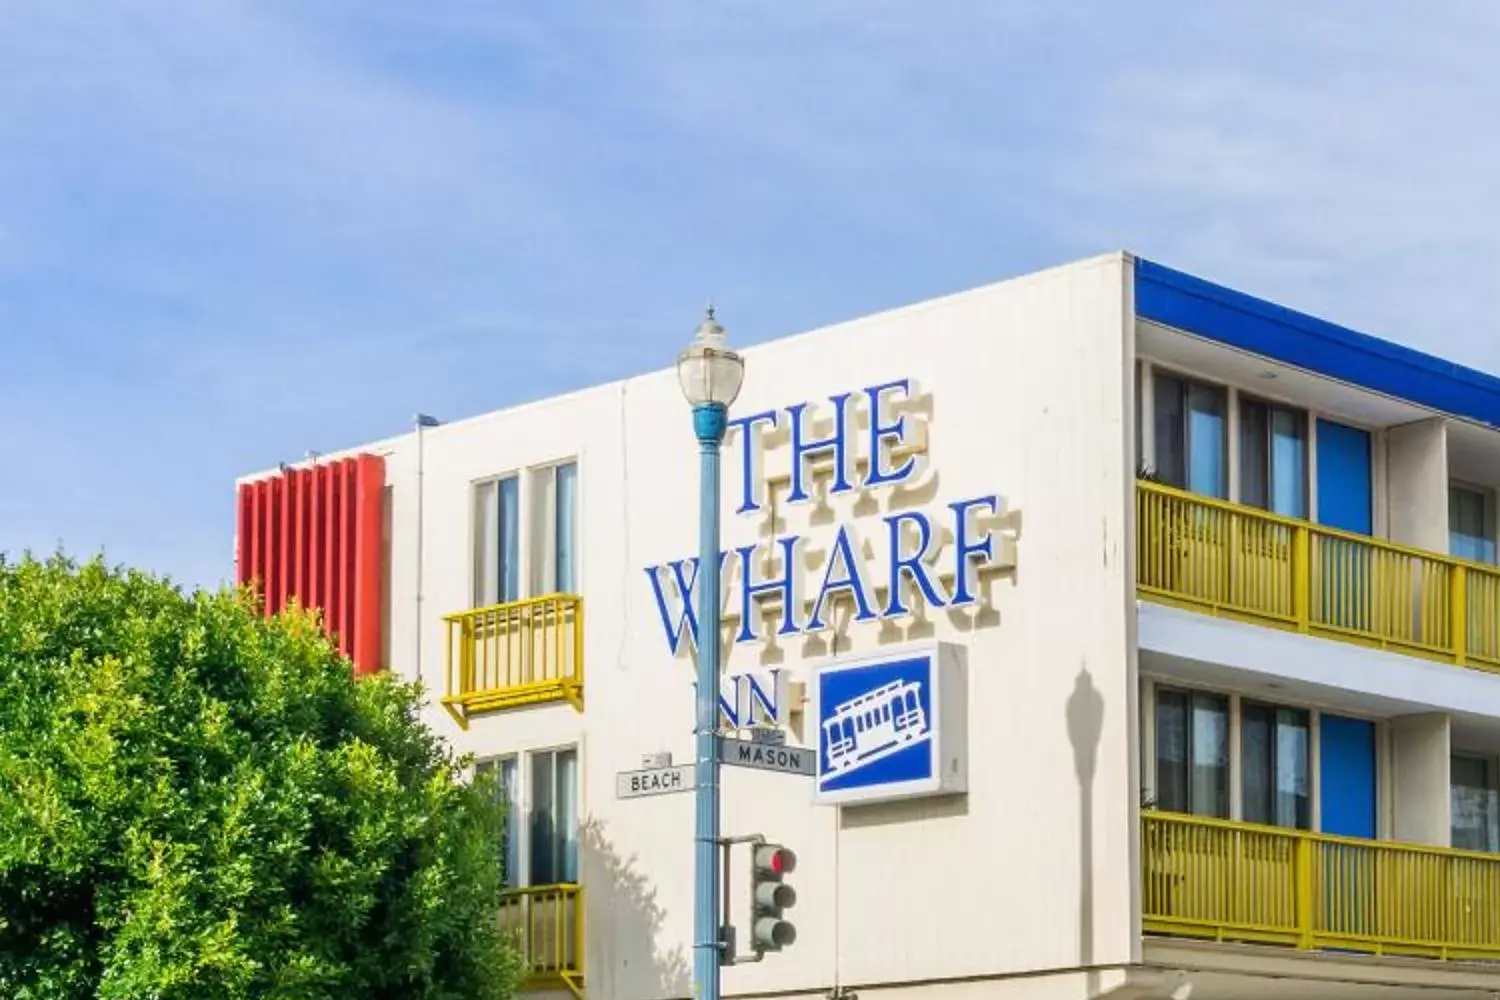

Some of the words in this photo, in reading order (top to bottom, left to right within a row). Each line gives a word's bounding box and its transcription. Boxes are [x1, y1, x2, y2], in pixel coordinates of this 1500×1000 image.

[727, 378, 916, 515] THE
[644, 495, 999, 656] WHARF
[631, 772, 681, 791] BEACH
[739, 746, 800, 768] MASON
